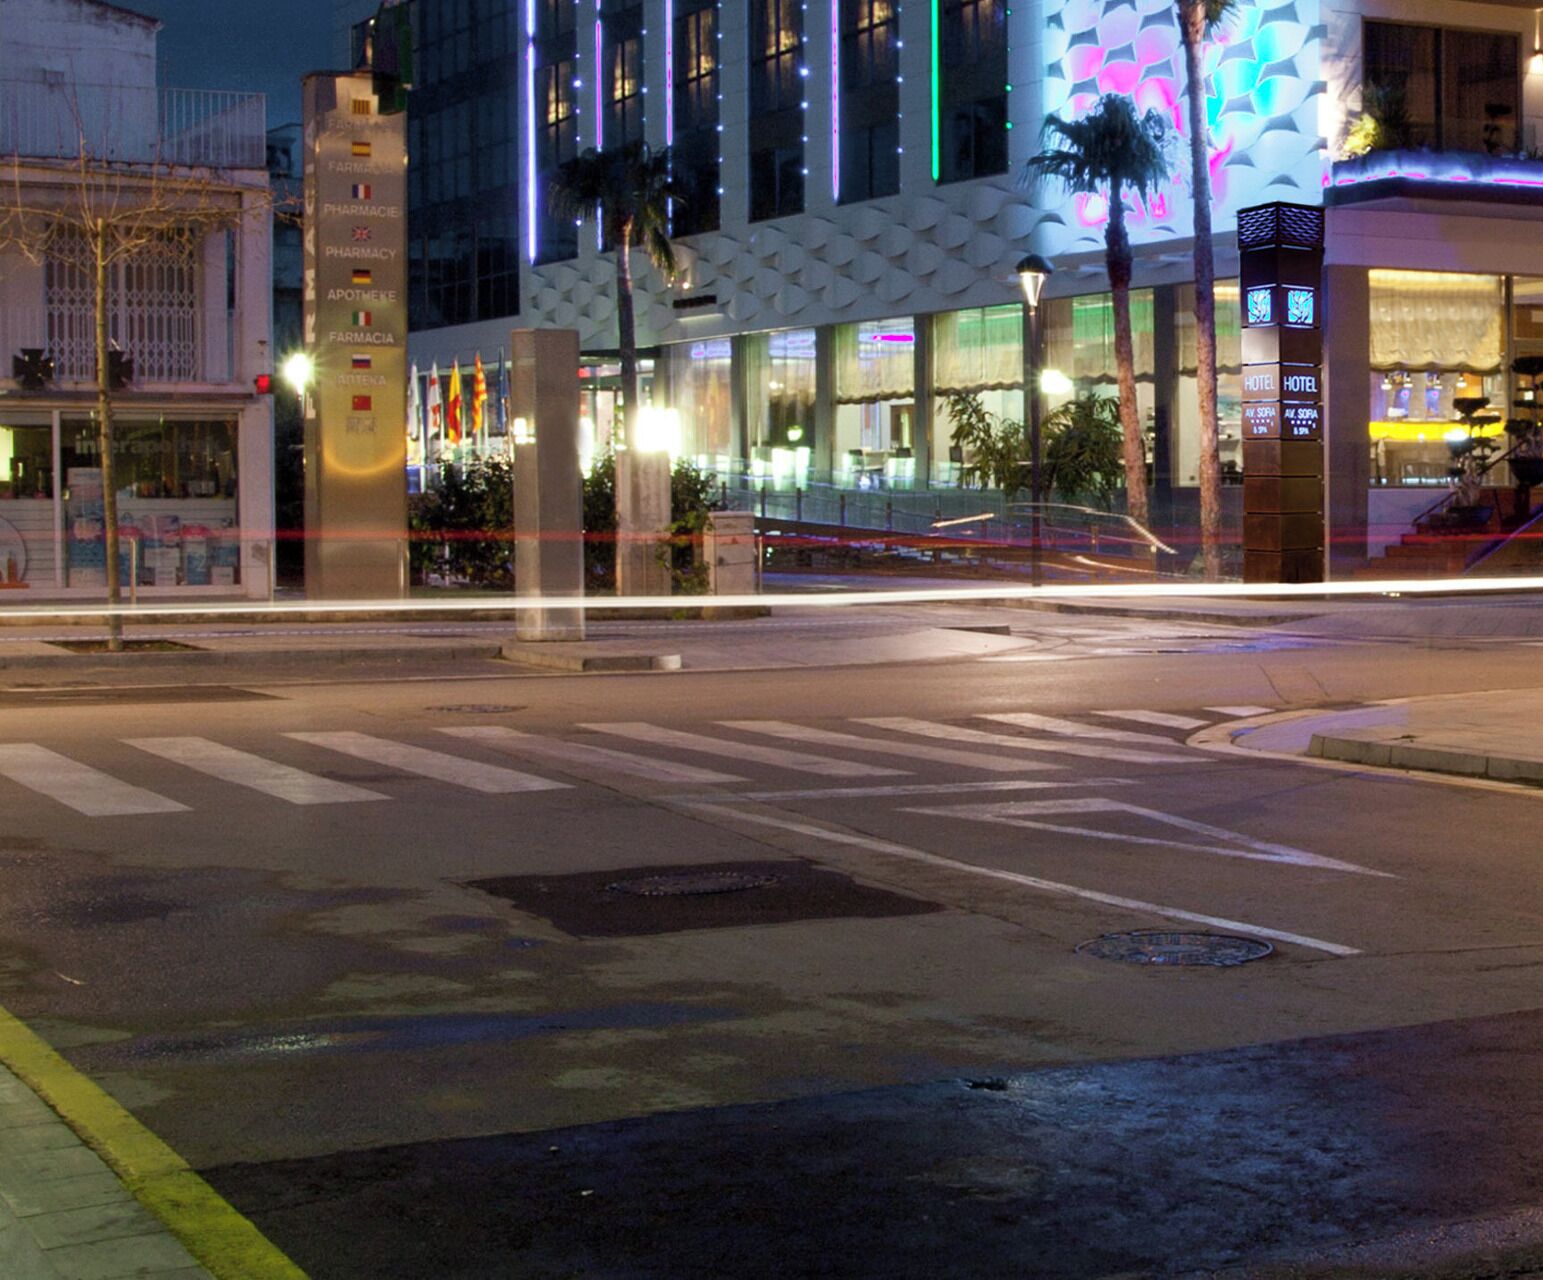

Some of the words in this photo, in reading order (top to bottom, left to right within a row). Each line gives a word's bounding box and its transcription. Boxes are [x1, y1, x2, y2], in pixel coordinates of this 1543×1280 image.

[323, 203, 399, 218] PHARMACIE
[325, 246, 397, 260] PHARMACY
[305, 118, 317, 419] FRMACIA
[327, 288, 397, 302] APOTHEKE
[329, 331, 395, 344] FARMACIA
[1244, 375, 1275, 391] HOTEL
[1283, 375, 1318, 392] HOTEL
